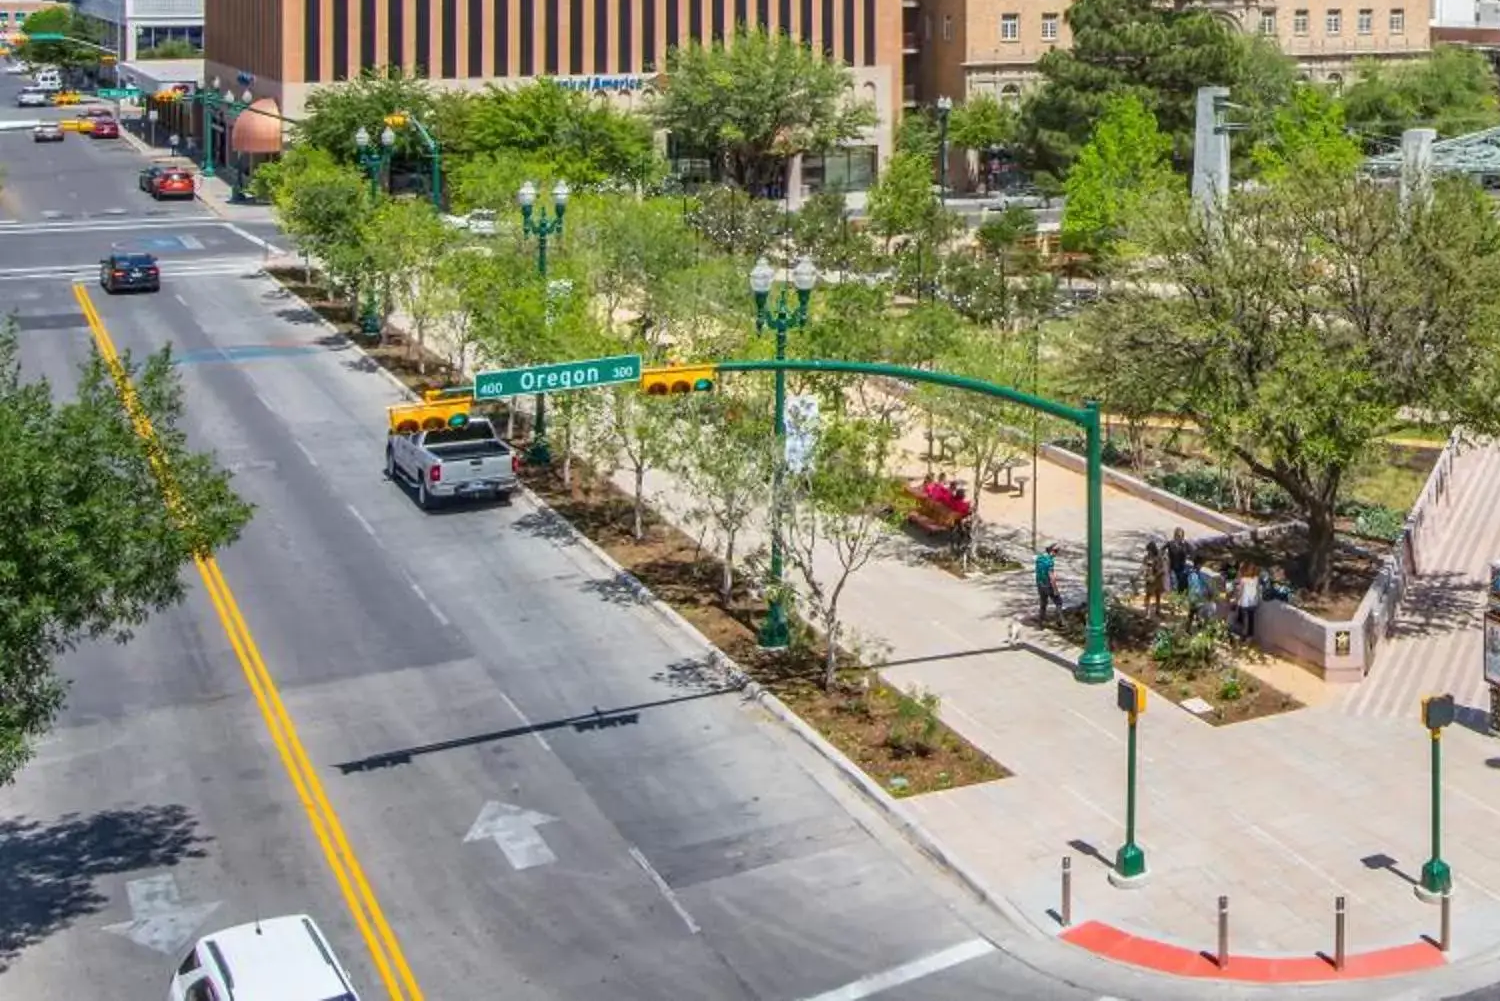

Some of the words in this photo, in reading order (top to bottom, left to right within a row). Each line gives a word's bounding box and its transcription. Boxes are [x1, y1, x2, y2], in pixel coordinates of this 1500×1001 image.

[480, 382, 503, 395] 400
[520, 366, 599, 390] Oregon
[611, 365, 633, 379] 300
